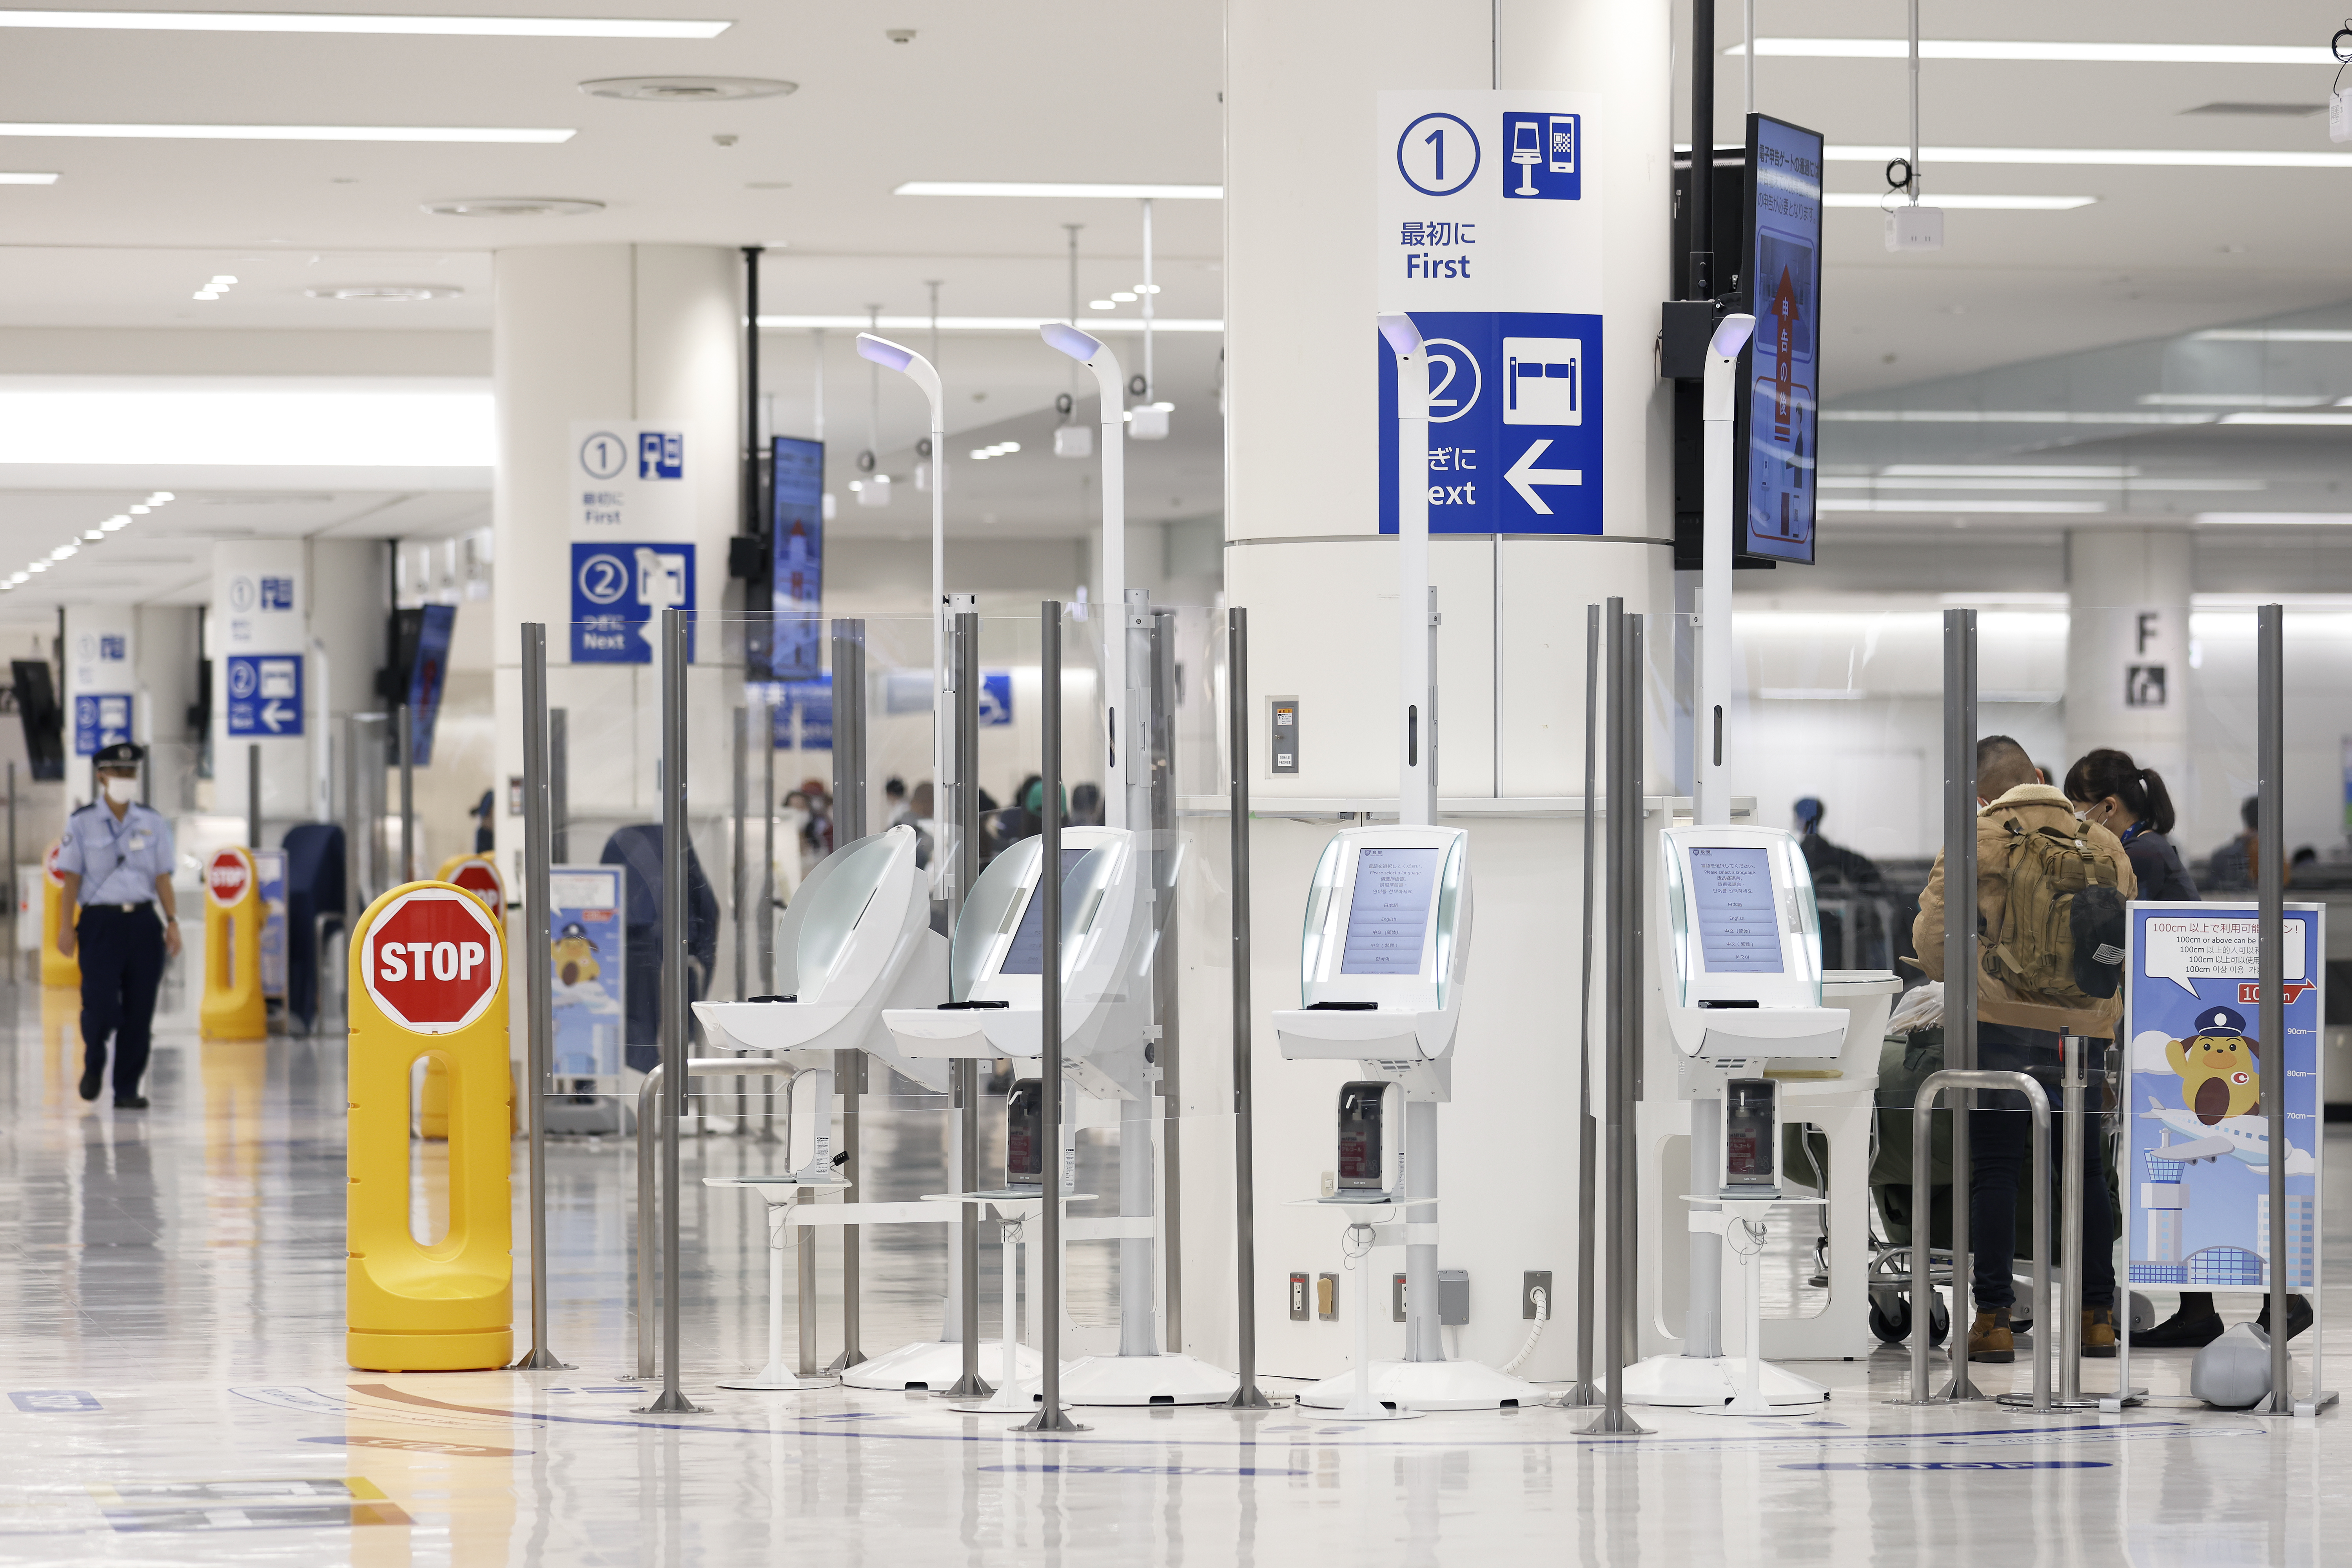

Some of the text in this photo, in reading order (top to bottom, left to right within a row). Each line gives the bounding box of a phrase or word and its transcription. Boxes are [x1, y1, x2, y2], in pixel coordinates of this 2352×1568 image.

[1758, 192, 1816, 224] の申告が必要となります。
[1401, 221, 1475, 246] 最初に
[1407, 252, 1470, 278] First
[1428, 447, 1476, 470] ぎに
[1428, 481, 1476, 505] ext
[586, 510, 621, 525] First
[583, 635, 624, 649] Next
[2137, 612, 2158, 654] F
[212, 866, 244, 886] STOP
[2153, 924, 2186, 932] 100cm
[381, 942, 485, 982] STOP
[348, 1439, 487, 1452] STOP
